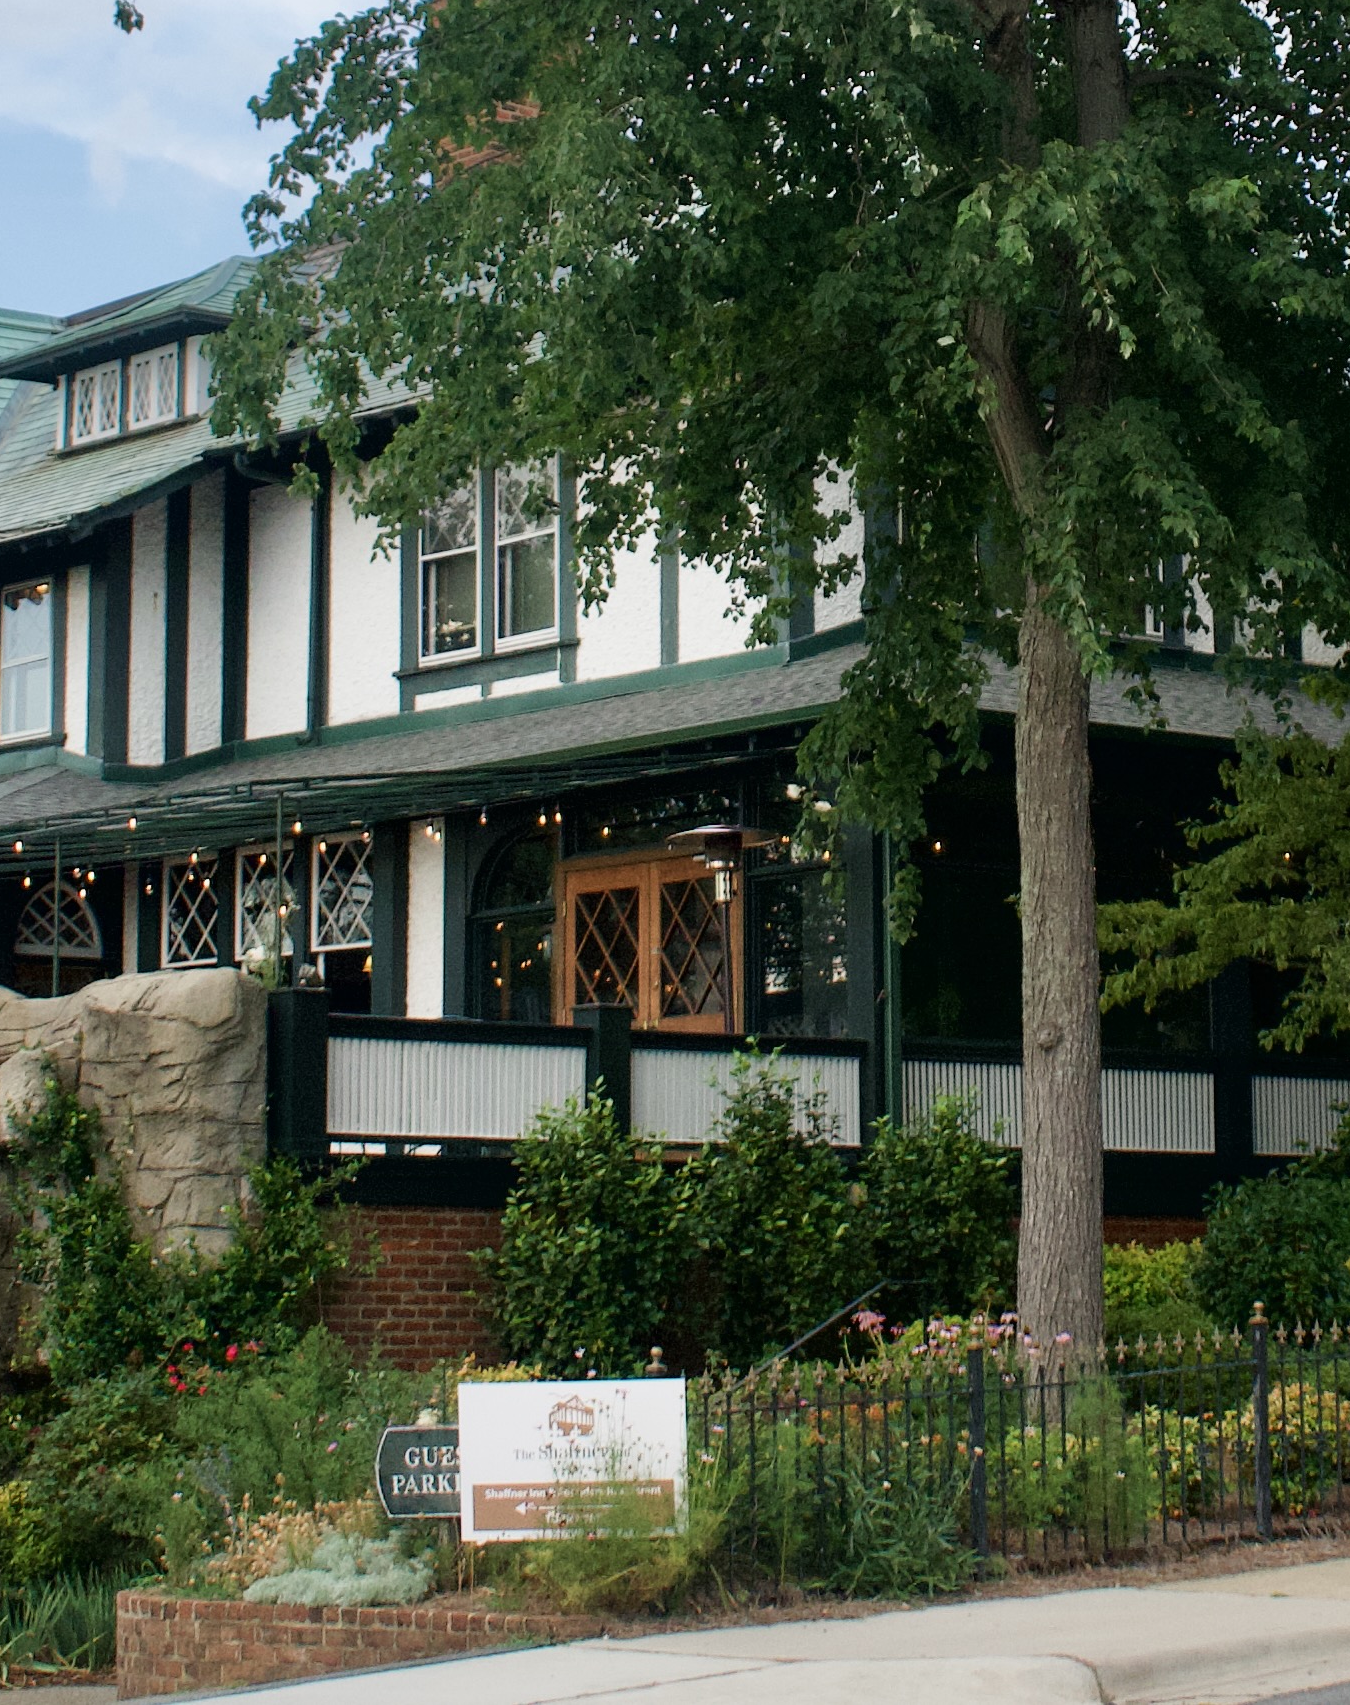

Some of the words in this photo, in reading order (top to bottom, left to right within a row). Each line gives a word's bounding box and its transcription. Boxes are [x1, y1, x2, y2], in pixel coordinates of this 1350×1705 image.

[513, 1448, 536, 1460] The
[538, 1443, 608, 1460] Shaffner
[485, 1487, 528, 1500] Shaffner
[530, 1488, 546, 1498] Inn
